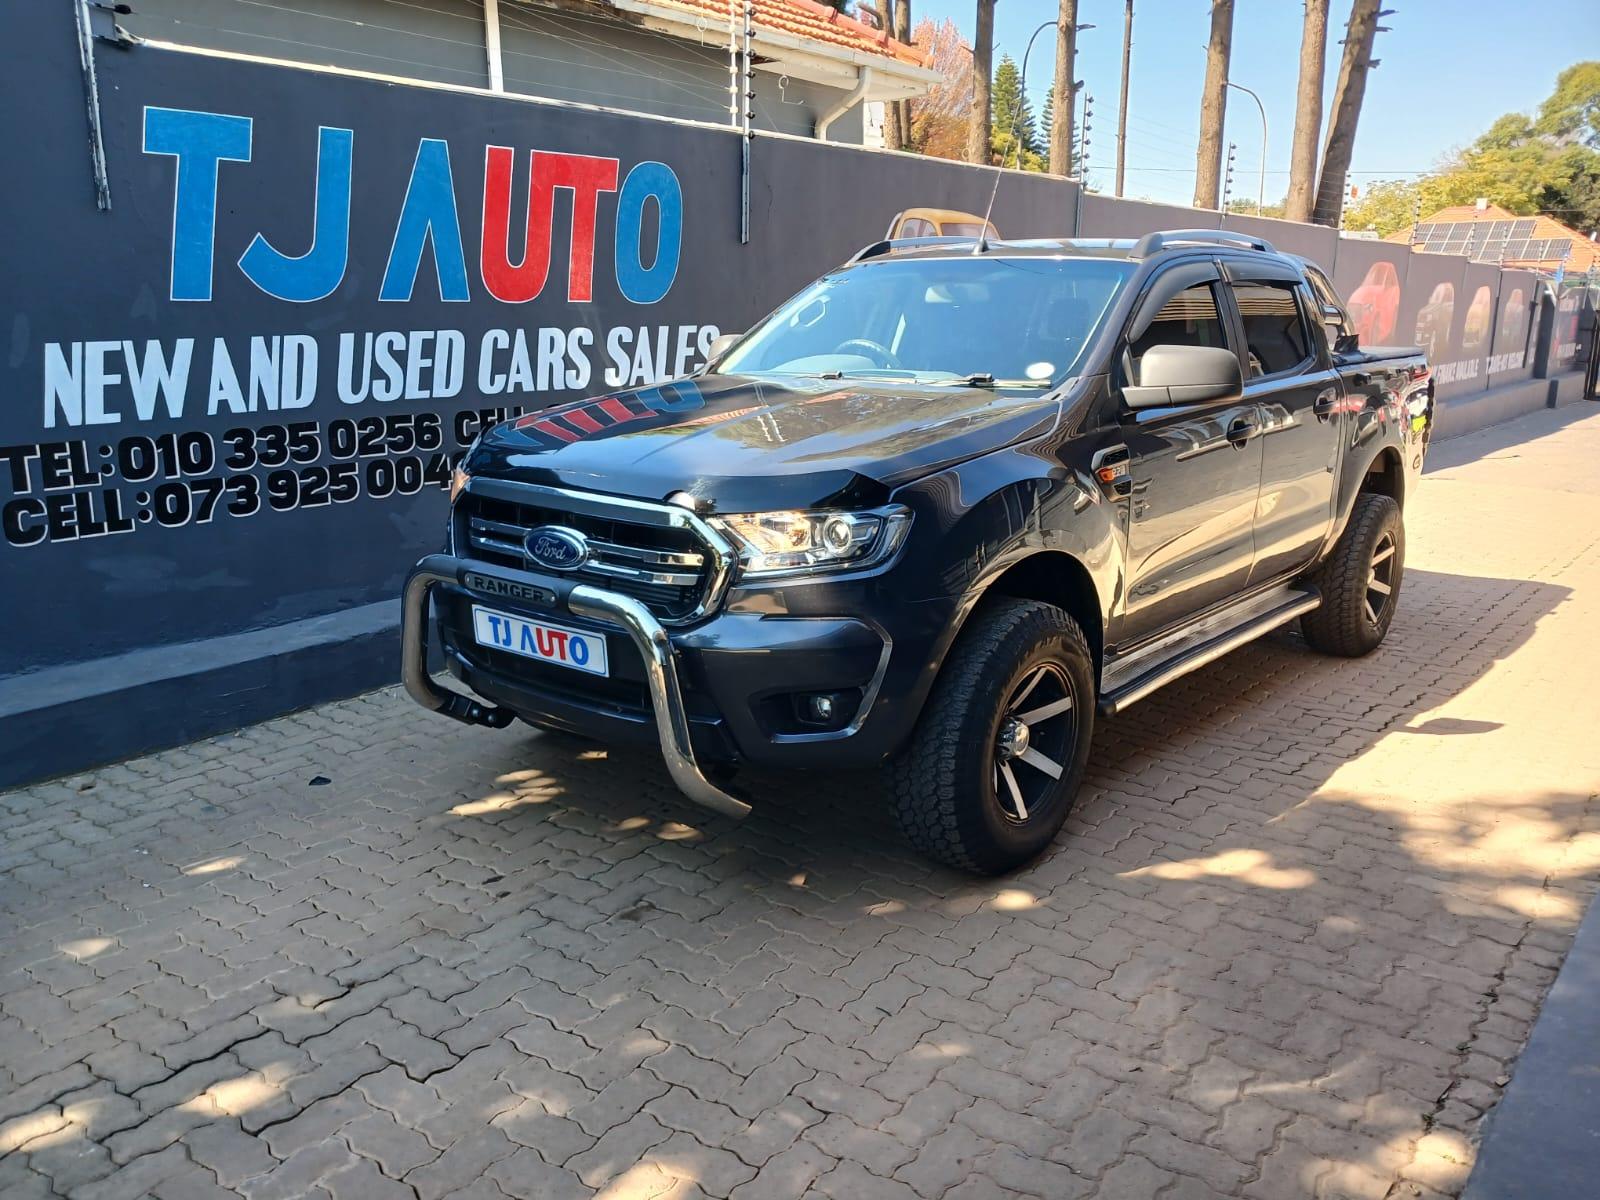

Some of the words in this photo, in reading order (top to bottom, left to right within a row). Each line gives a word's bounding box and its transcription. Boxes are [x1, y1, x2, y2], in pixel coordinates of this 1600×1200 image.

[142, 106, 354, 303] TJ
[378, 138, 684, 304] AUTO
[44, 338, 195, 428] NEW
[208, 334, 318, 415] AND
[338, 329, 465, 404] USED
[478, 327, 595, 394] CARS
[604, 325, 720, 387] SALES
[223, 421, 321, 471] 335
[328, 413, 441, 460] 0256
[267, 462, 360, 512] 925
[534, 536, 568, 560] Ford
[474, 576, 544, 601] RANGER
[488, 616, 512, 647] TJ
[521, 624, 589, 666] AUTO
